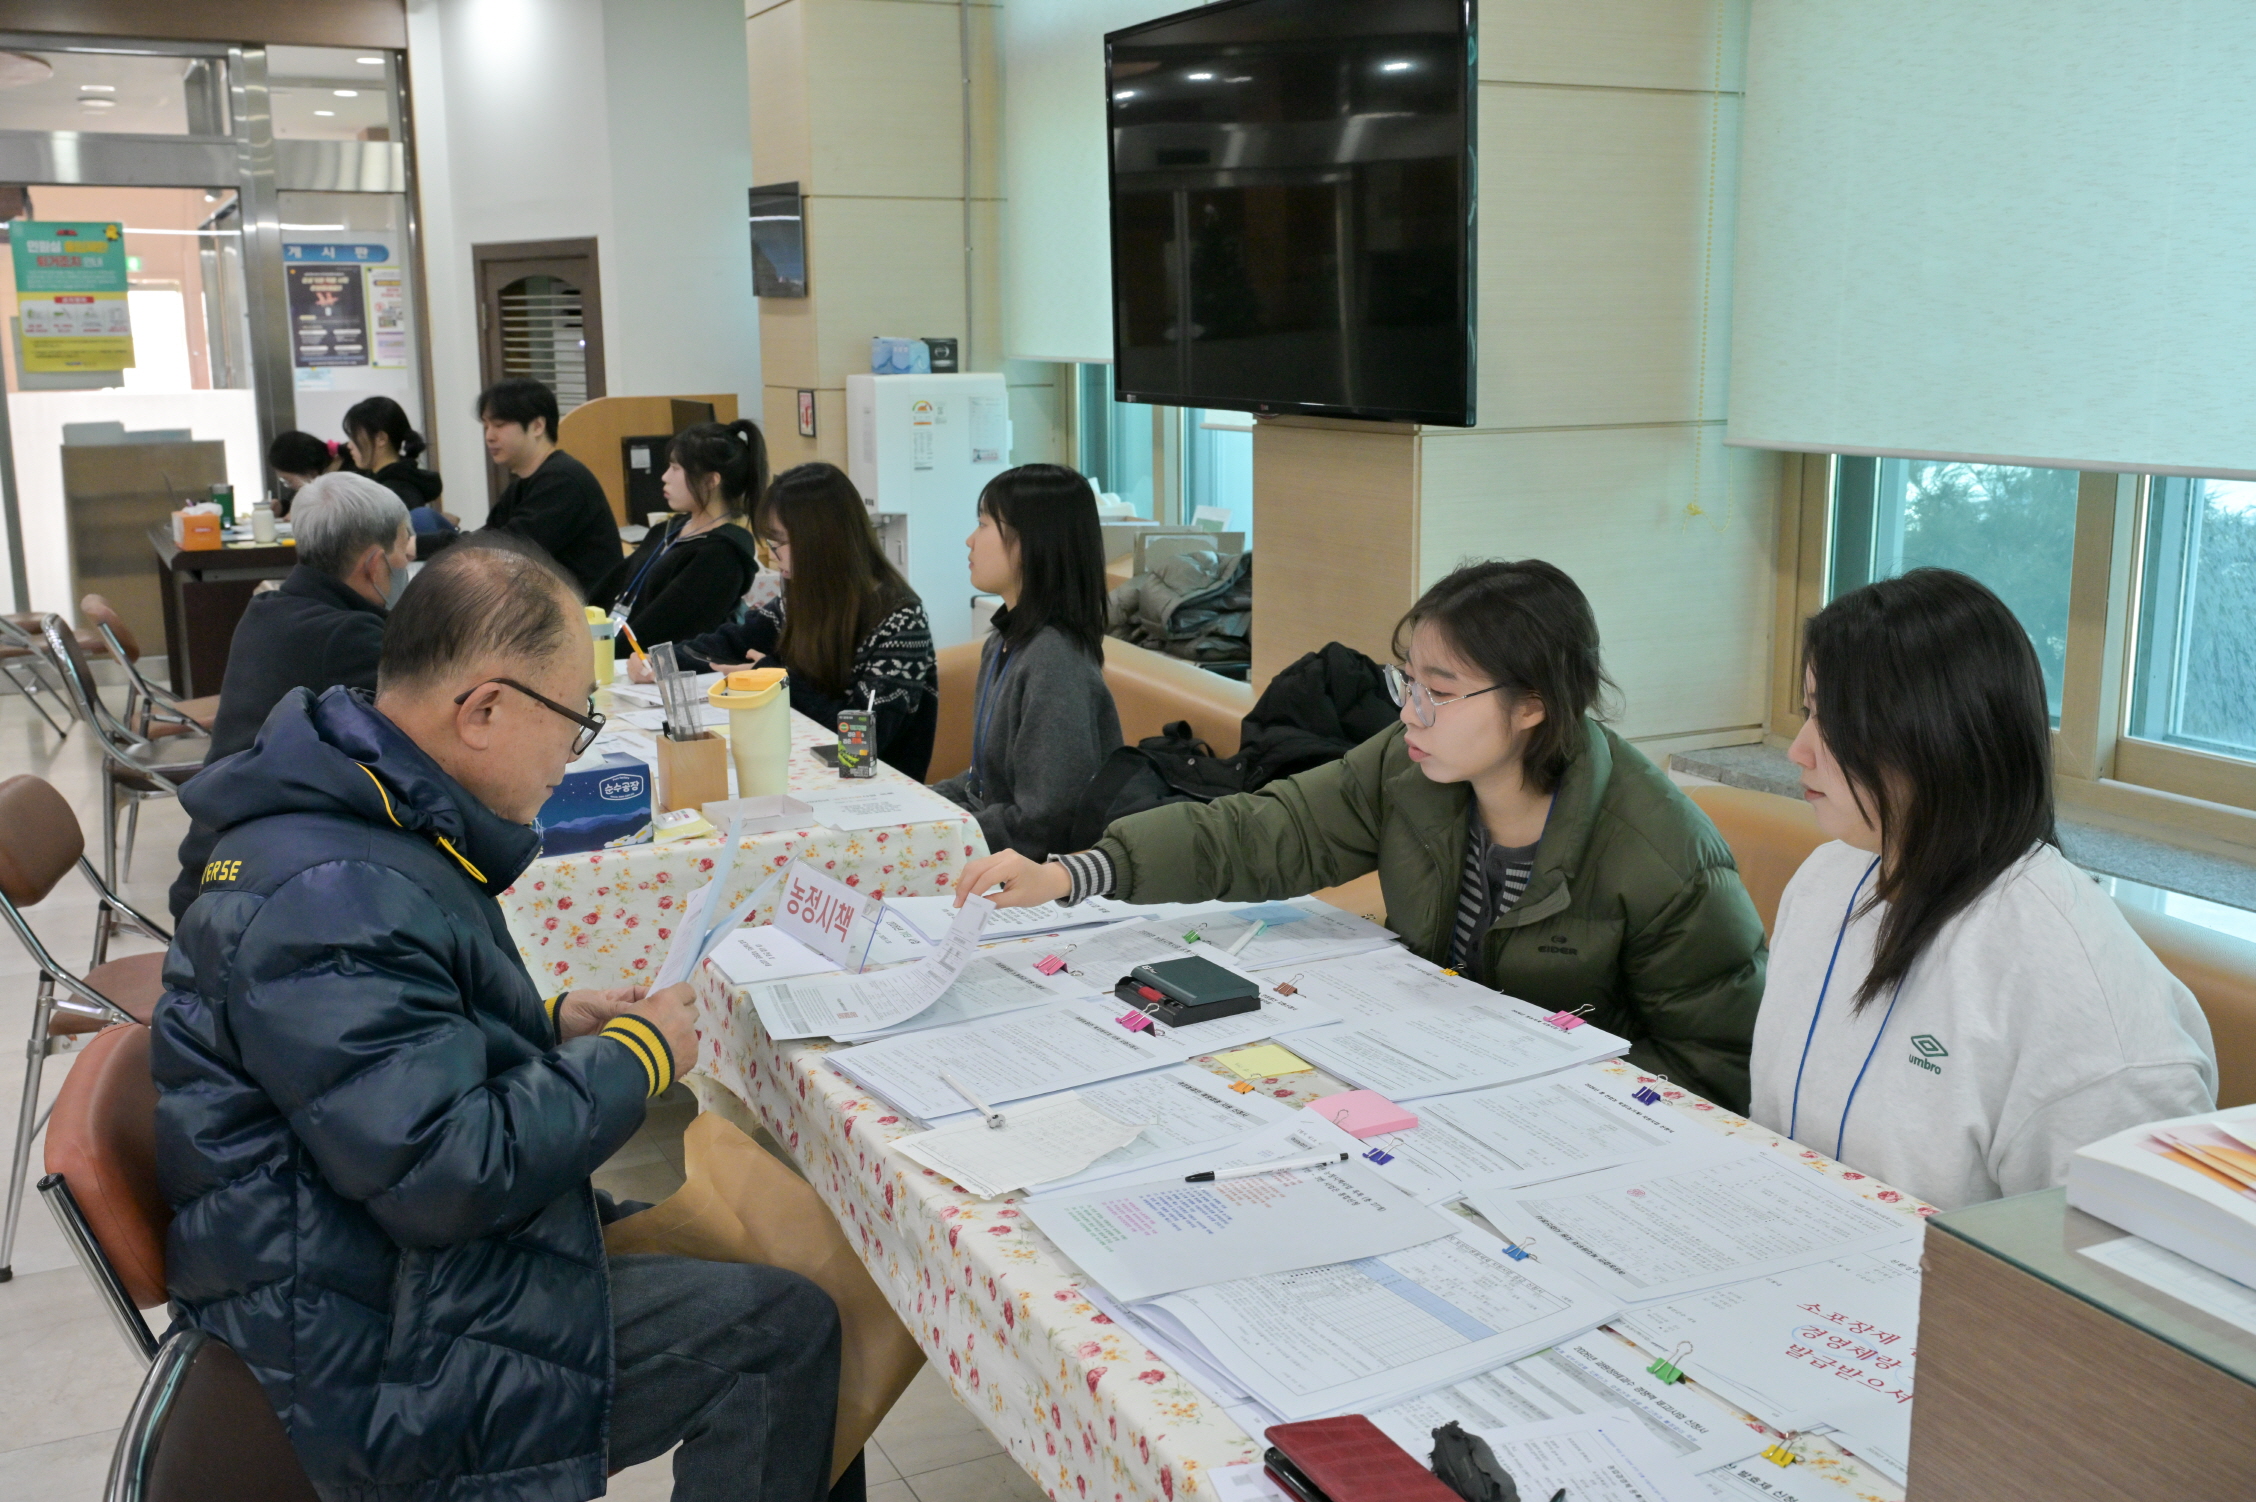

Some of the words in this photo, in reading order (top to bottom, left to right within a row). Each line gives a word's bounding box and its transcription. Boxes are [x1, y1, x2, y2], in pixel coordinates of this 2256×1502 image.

[605, 781, 639, 794] 순수공장
[787, 877, 854, 943] 농정시책
[1538, 946, 1578, 955] EIDER
[1908, 1054, 1941, 1075] umbro
[1797, 1303, 1901, 1345] 소포장재
[1801, 1325, 1902, 1370] 경영체랑
[1570, 1345, 1600, 1361] 2026년
[1681, 1419, 1708, 1432] 신청서
[1737, 1470, 1773, 1490] 발효제
